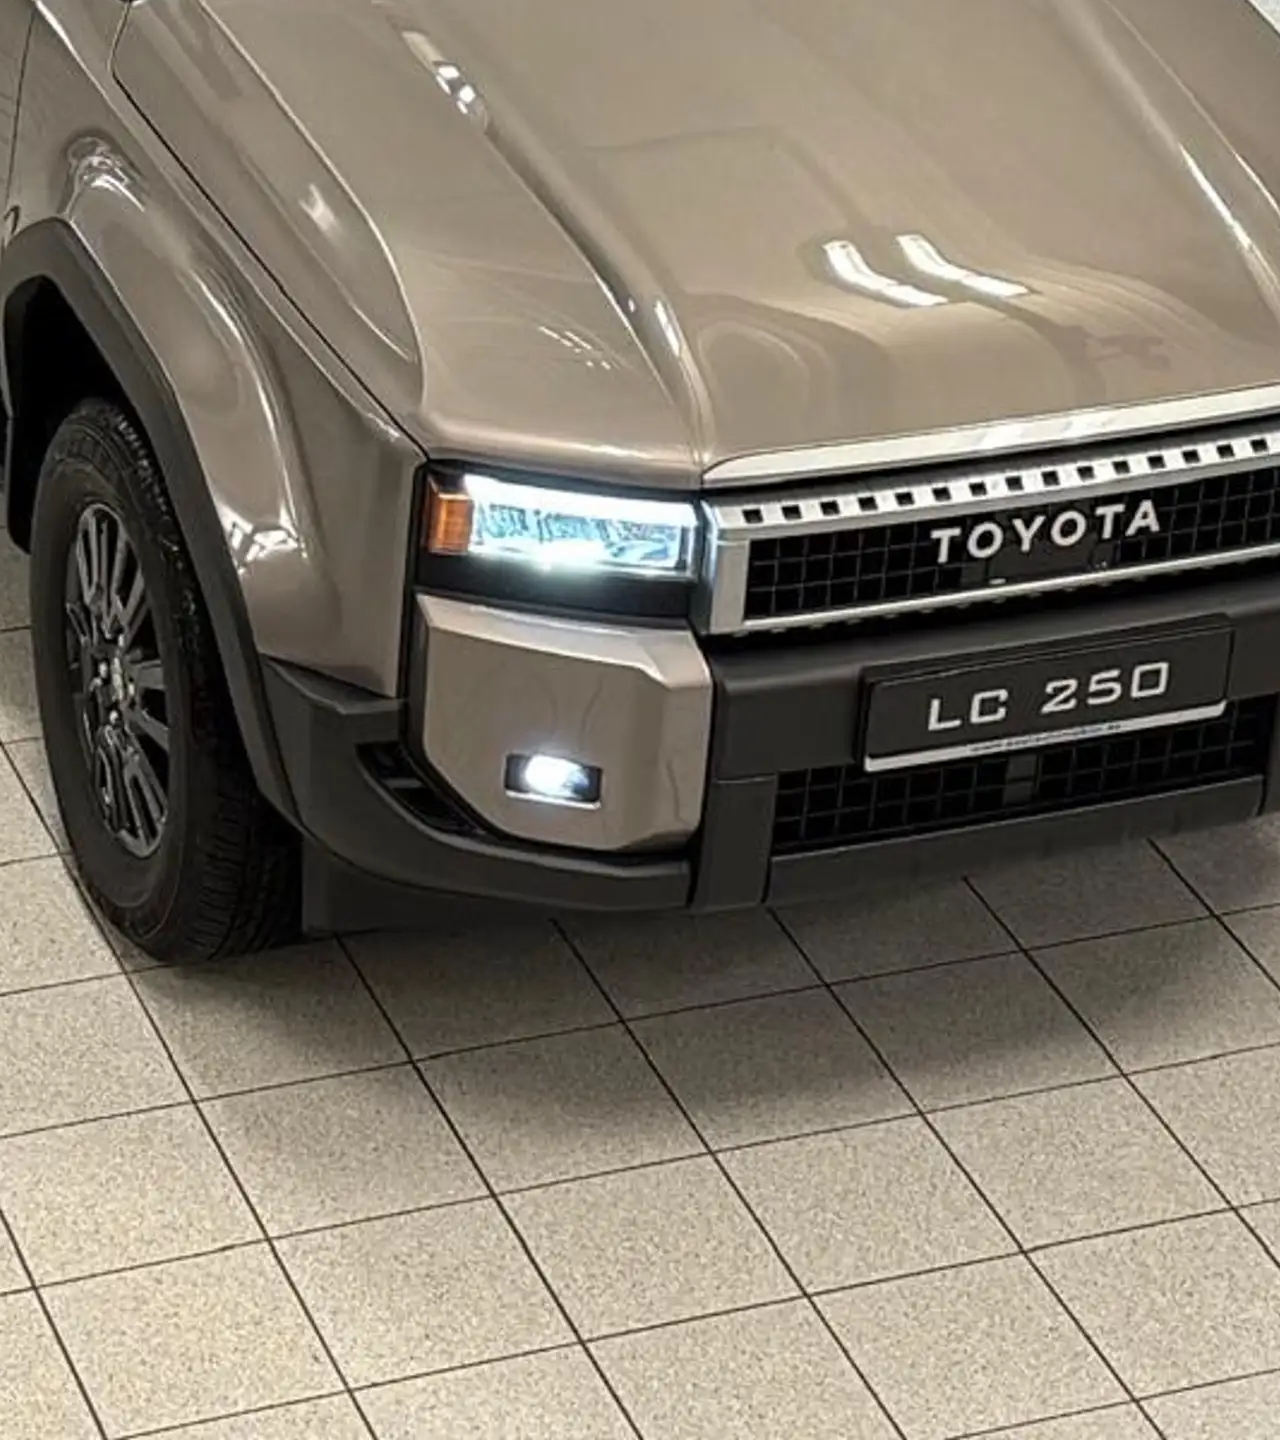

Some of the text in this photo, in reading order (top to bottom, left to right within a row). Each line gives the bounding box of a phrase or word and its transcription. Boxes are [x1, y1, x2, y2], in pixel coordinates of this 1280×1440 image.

[930, 499, 1160, 564] TOYOTA
[928, 661, 1170, 731] LC 250
